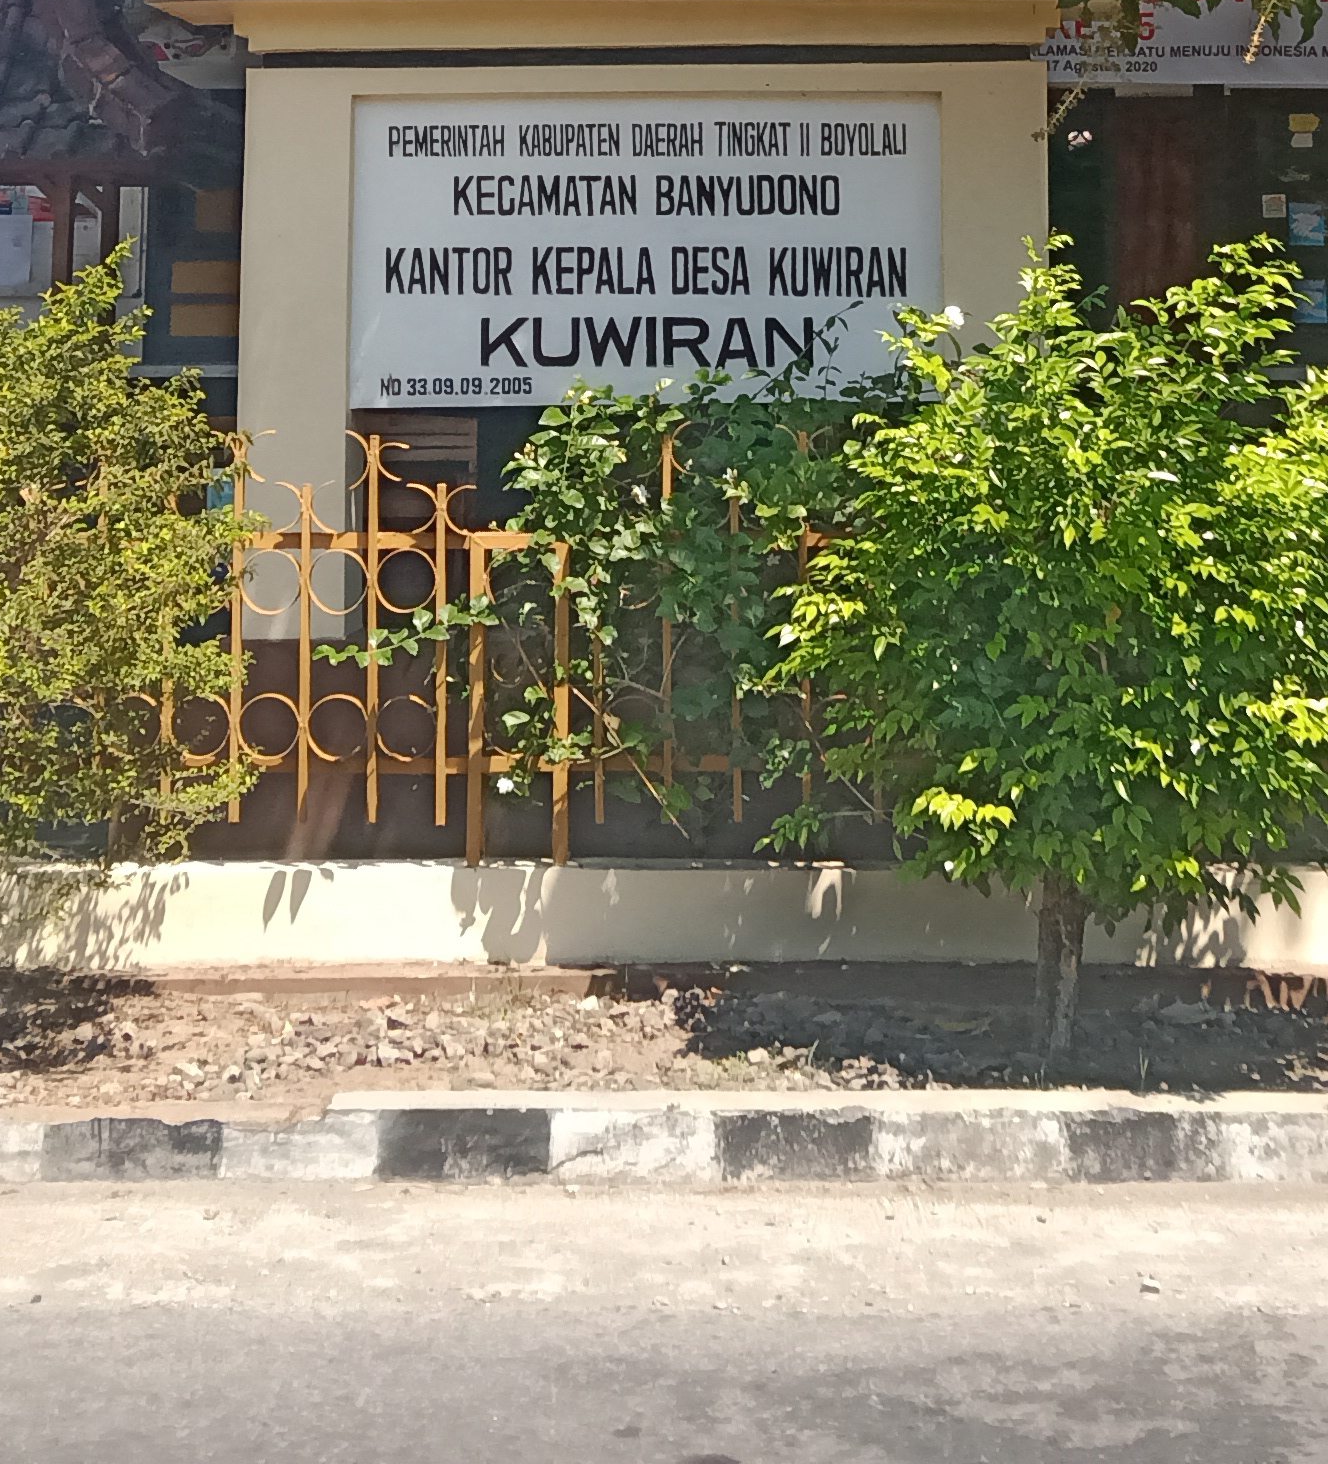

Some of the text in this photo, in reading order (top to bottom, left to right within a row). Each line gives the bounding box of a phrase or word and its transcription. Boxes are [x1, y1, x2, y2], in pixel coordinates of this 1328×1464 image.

[1125, 61, 1158, 73] 2020
[1170, 45, 1230, 58] MENUJU
[1236, 45, 1317, 58] INONESIA
[388, 121, 907, 157] PEMERINTAH KABUPATEN DAERAH TINGKAT II BOYOLALI
[453, 174, 840, 216] KECAMATAN BANYUDONO
[385, 246, 907, 298] KANTOR KEPALA DESA KUWIRAN
[480, 316, 814, 369] KUWIRAN
